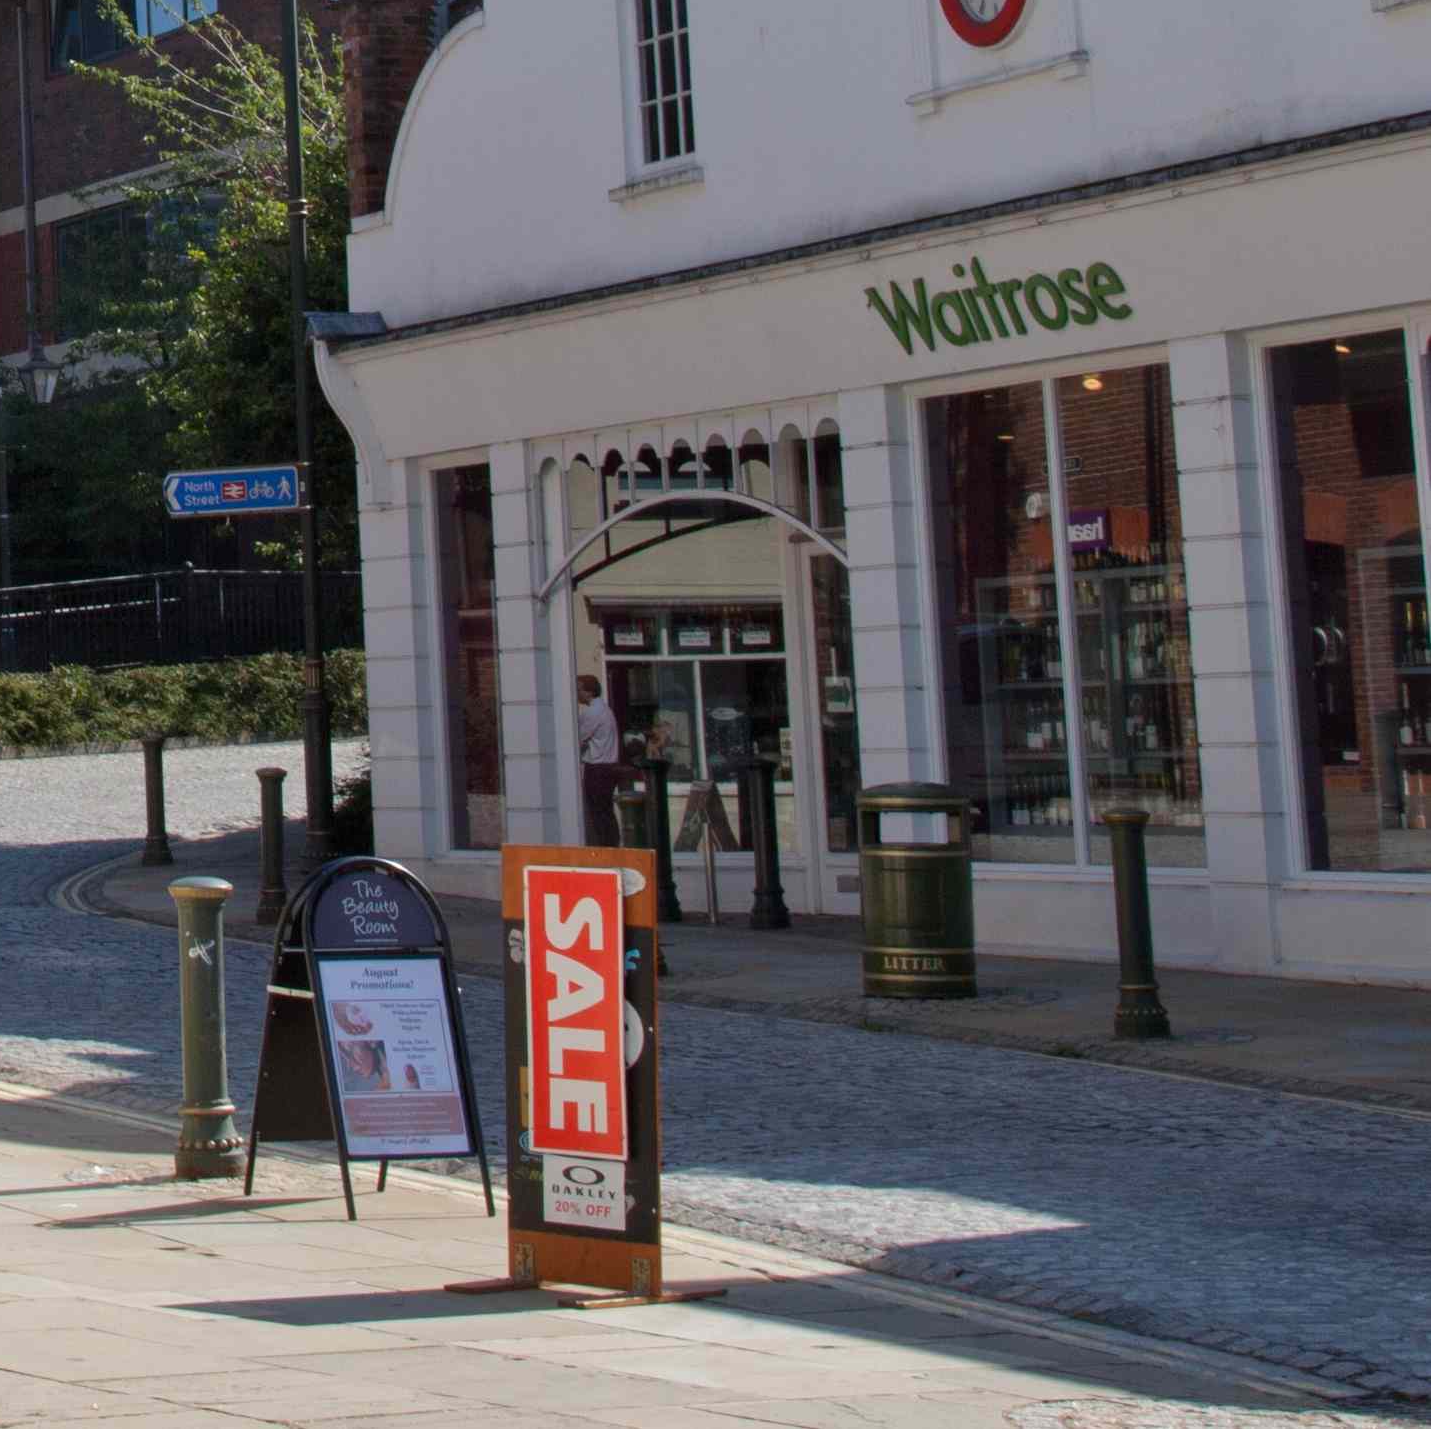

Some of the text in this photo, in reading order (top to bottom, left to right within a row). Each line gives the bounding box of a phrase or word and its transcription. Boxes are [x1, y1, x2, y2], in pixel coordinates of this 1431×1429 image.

[864, 256, 1133, 356] Waitrose
[183, 480, 215, 492] North
[184, 494, 220, 506] Street
[352, 879, 383, 898] The
[341, 896, 399, 920] Beauty
[350, 915, 397, 935] Room
[883, 955, 946, 972] LITTER
[362, 968, 398, 979] August
[544, 893, 608, 1135] SALE
[552, 1184, 618, 1200] OAKLEY
[555, 1200, 611, 1218] 20% OFF
